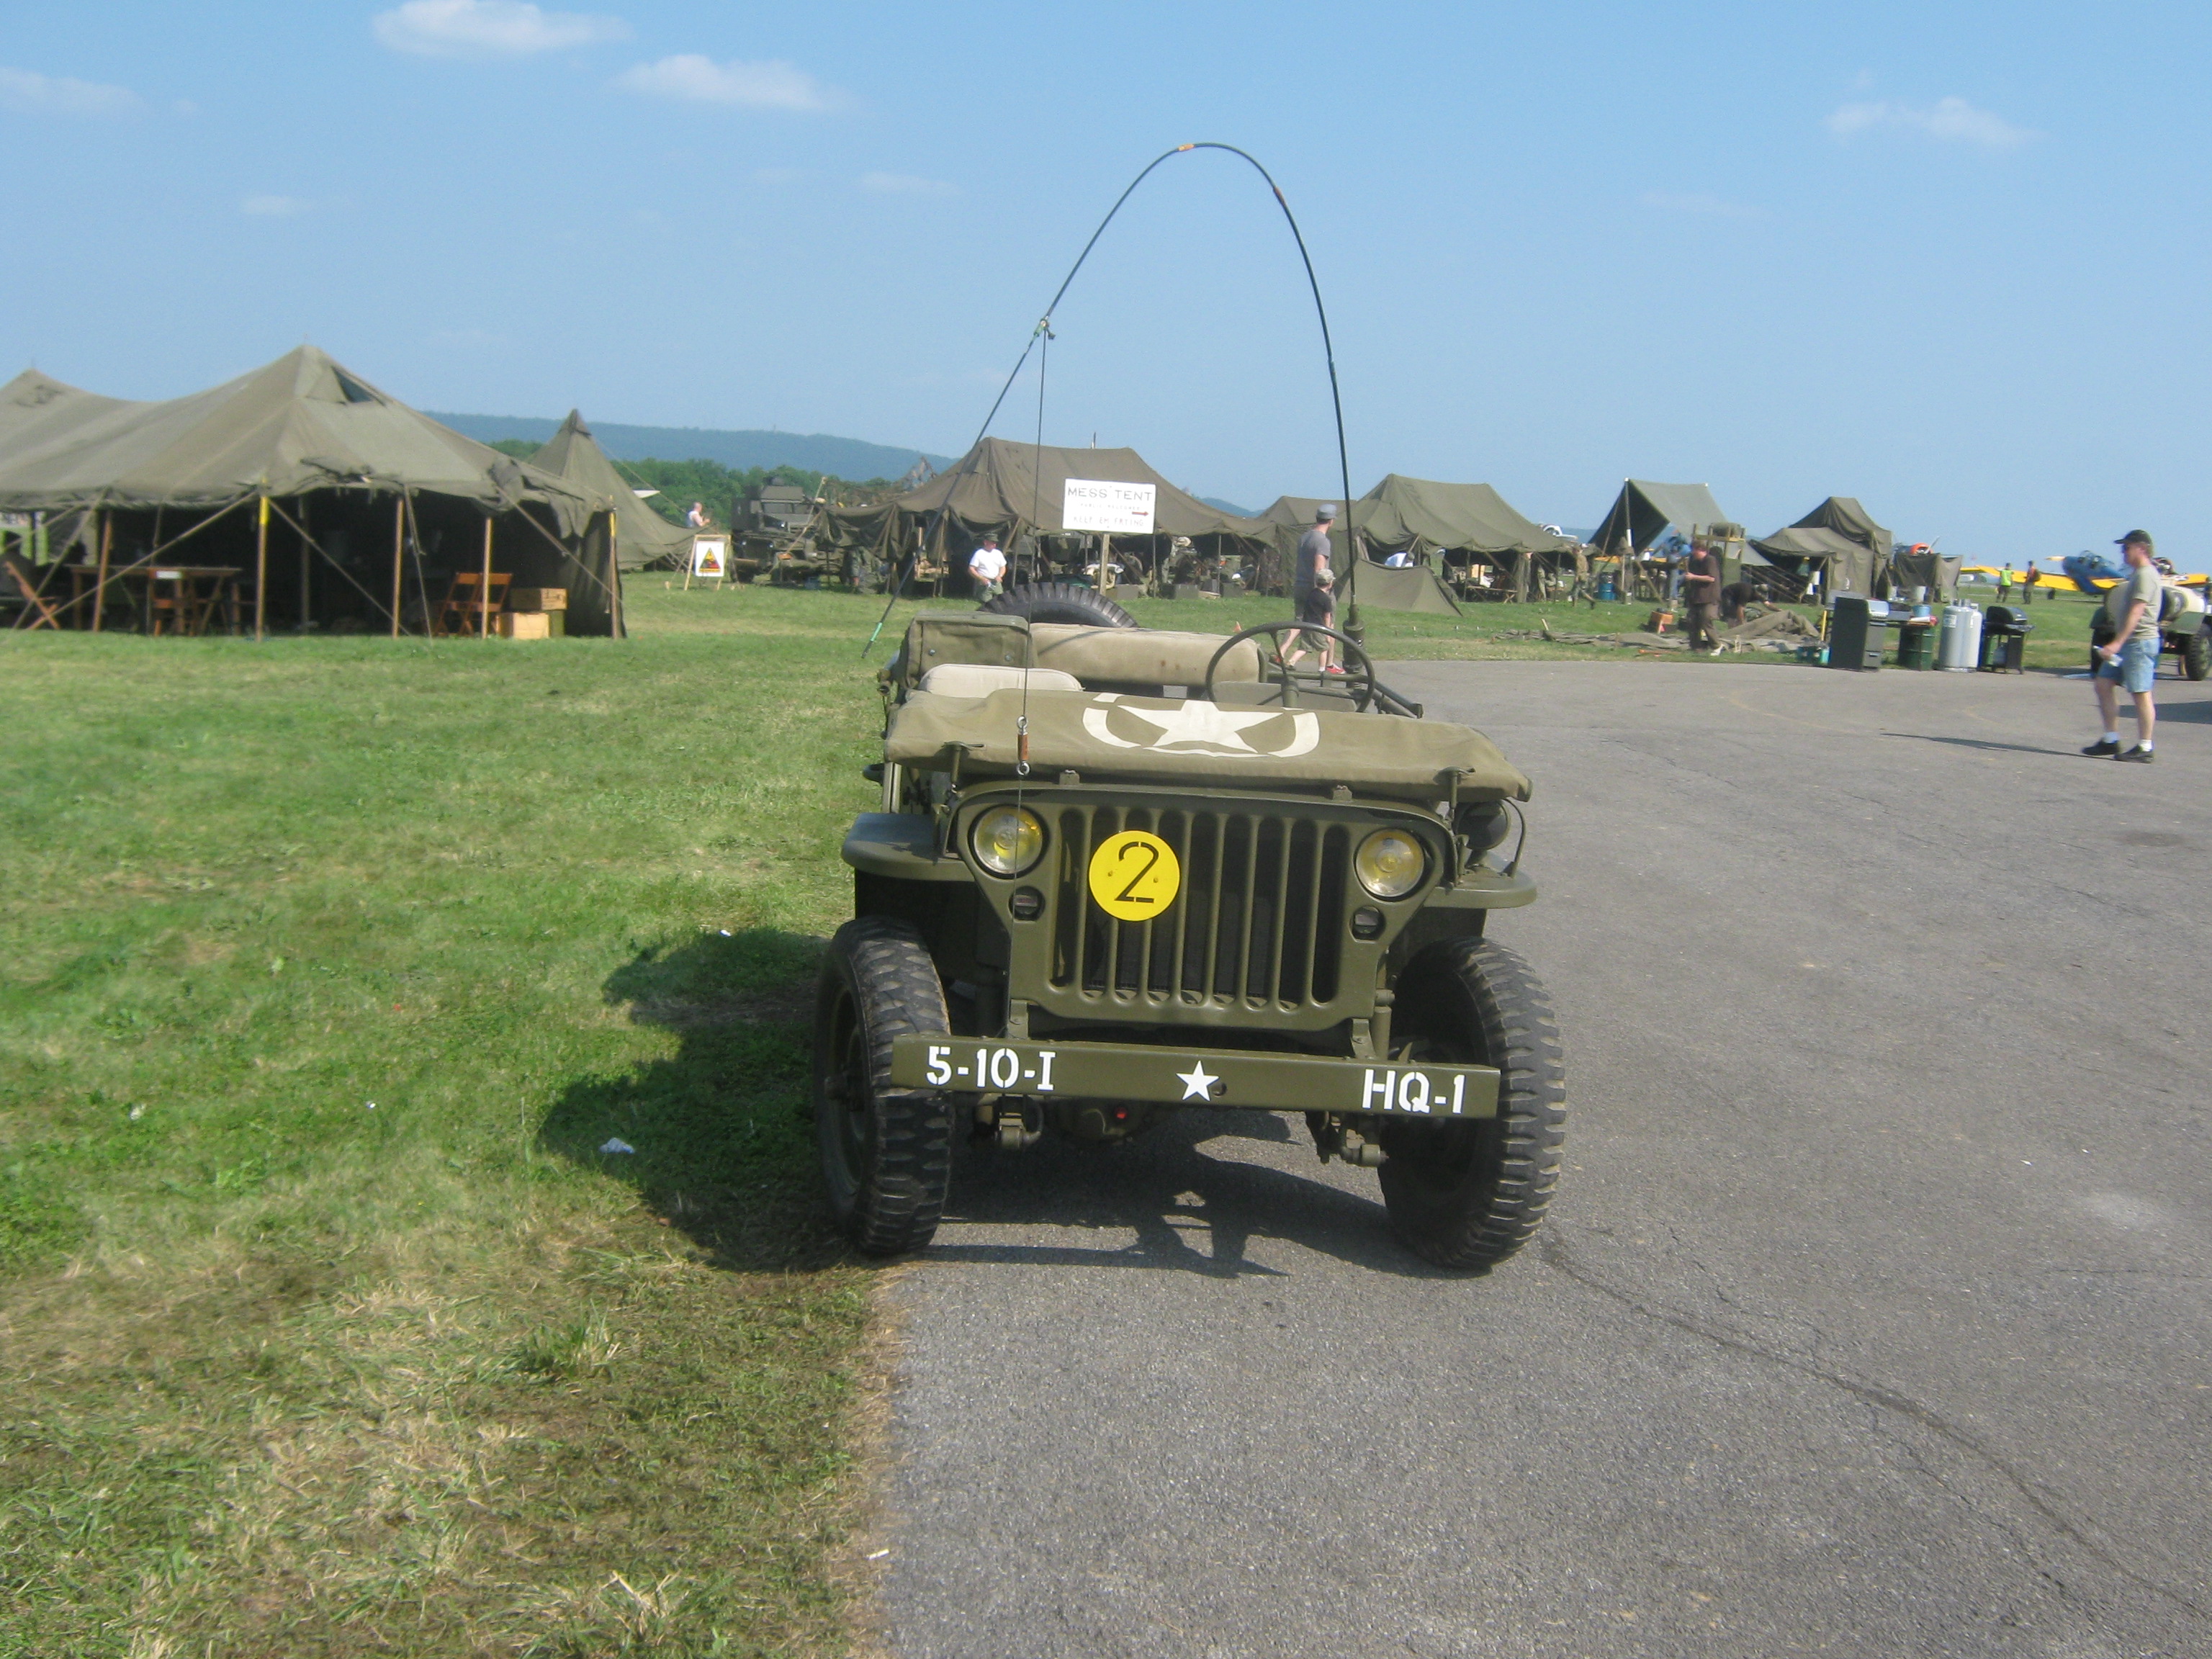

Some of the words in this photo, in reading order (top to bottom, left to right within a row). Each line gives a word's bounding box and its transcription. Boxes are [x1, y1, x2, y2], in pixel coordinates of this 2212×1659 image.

[1067, 487, 1107, 498] MESS
[1115, 490, 1153, 501] TENT
[1074, 516, 1093, 524] KEEP
[1114, 841, 1159, 904] 2
[1362, 1069, 1466, 1114] HQ-1
